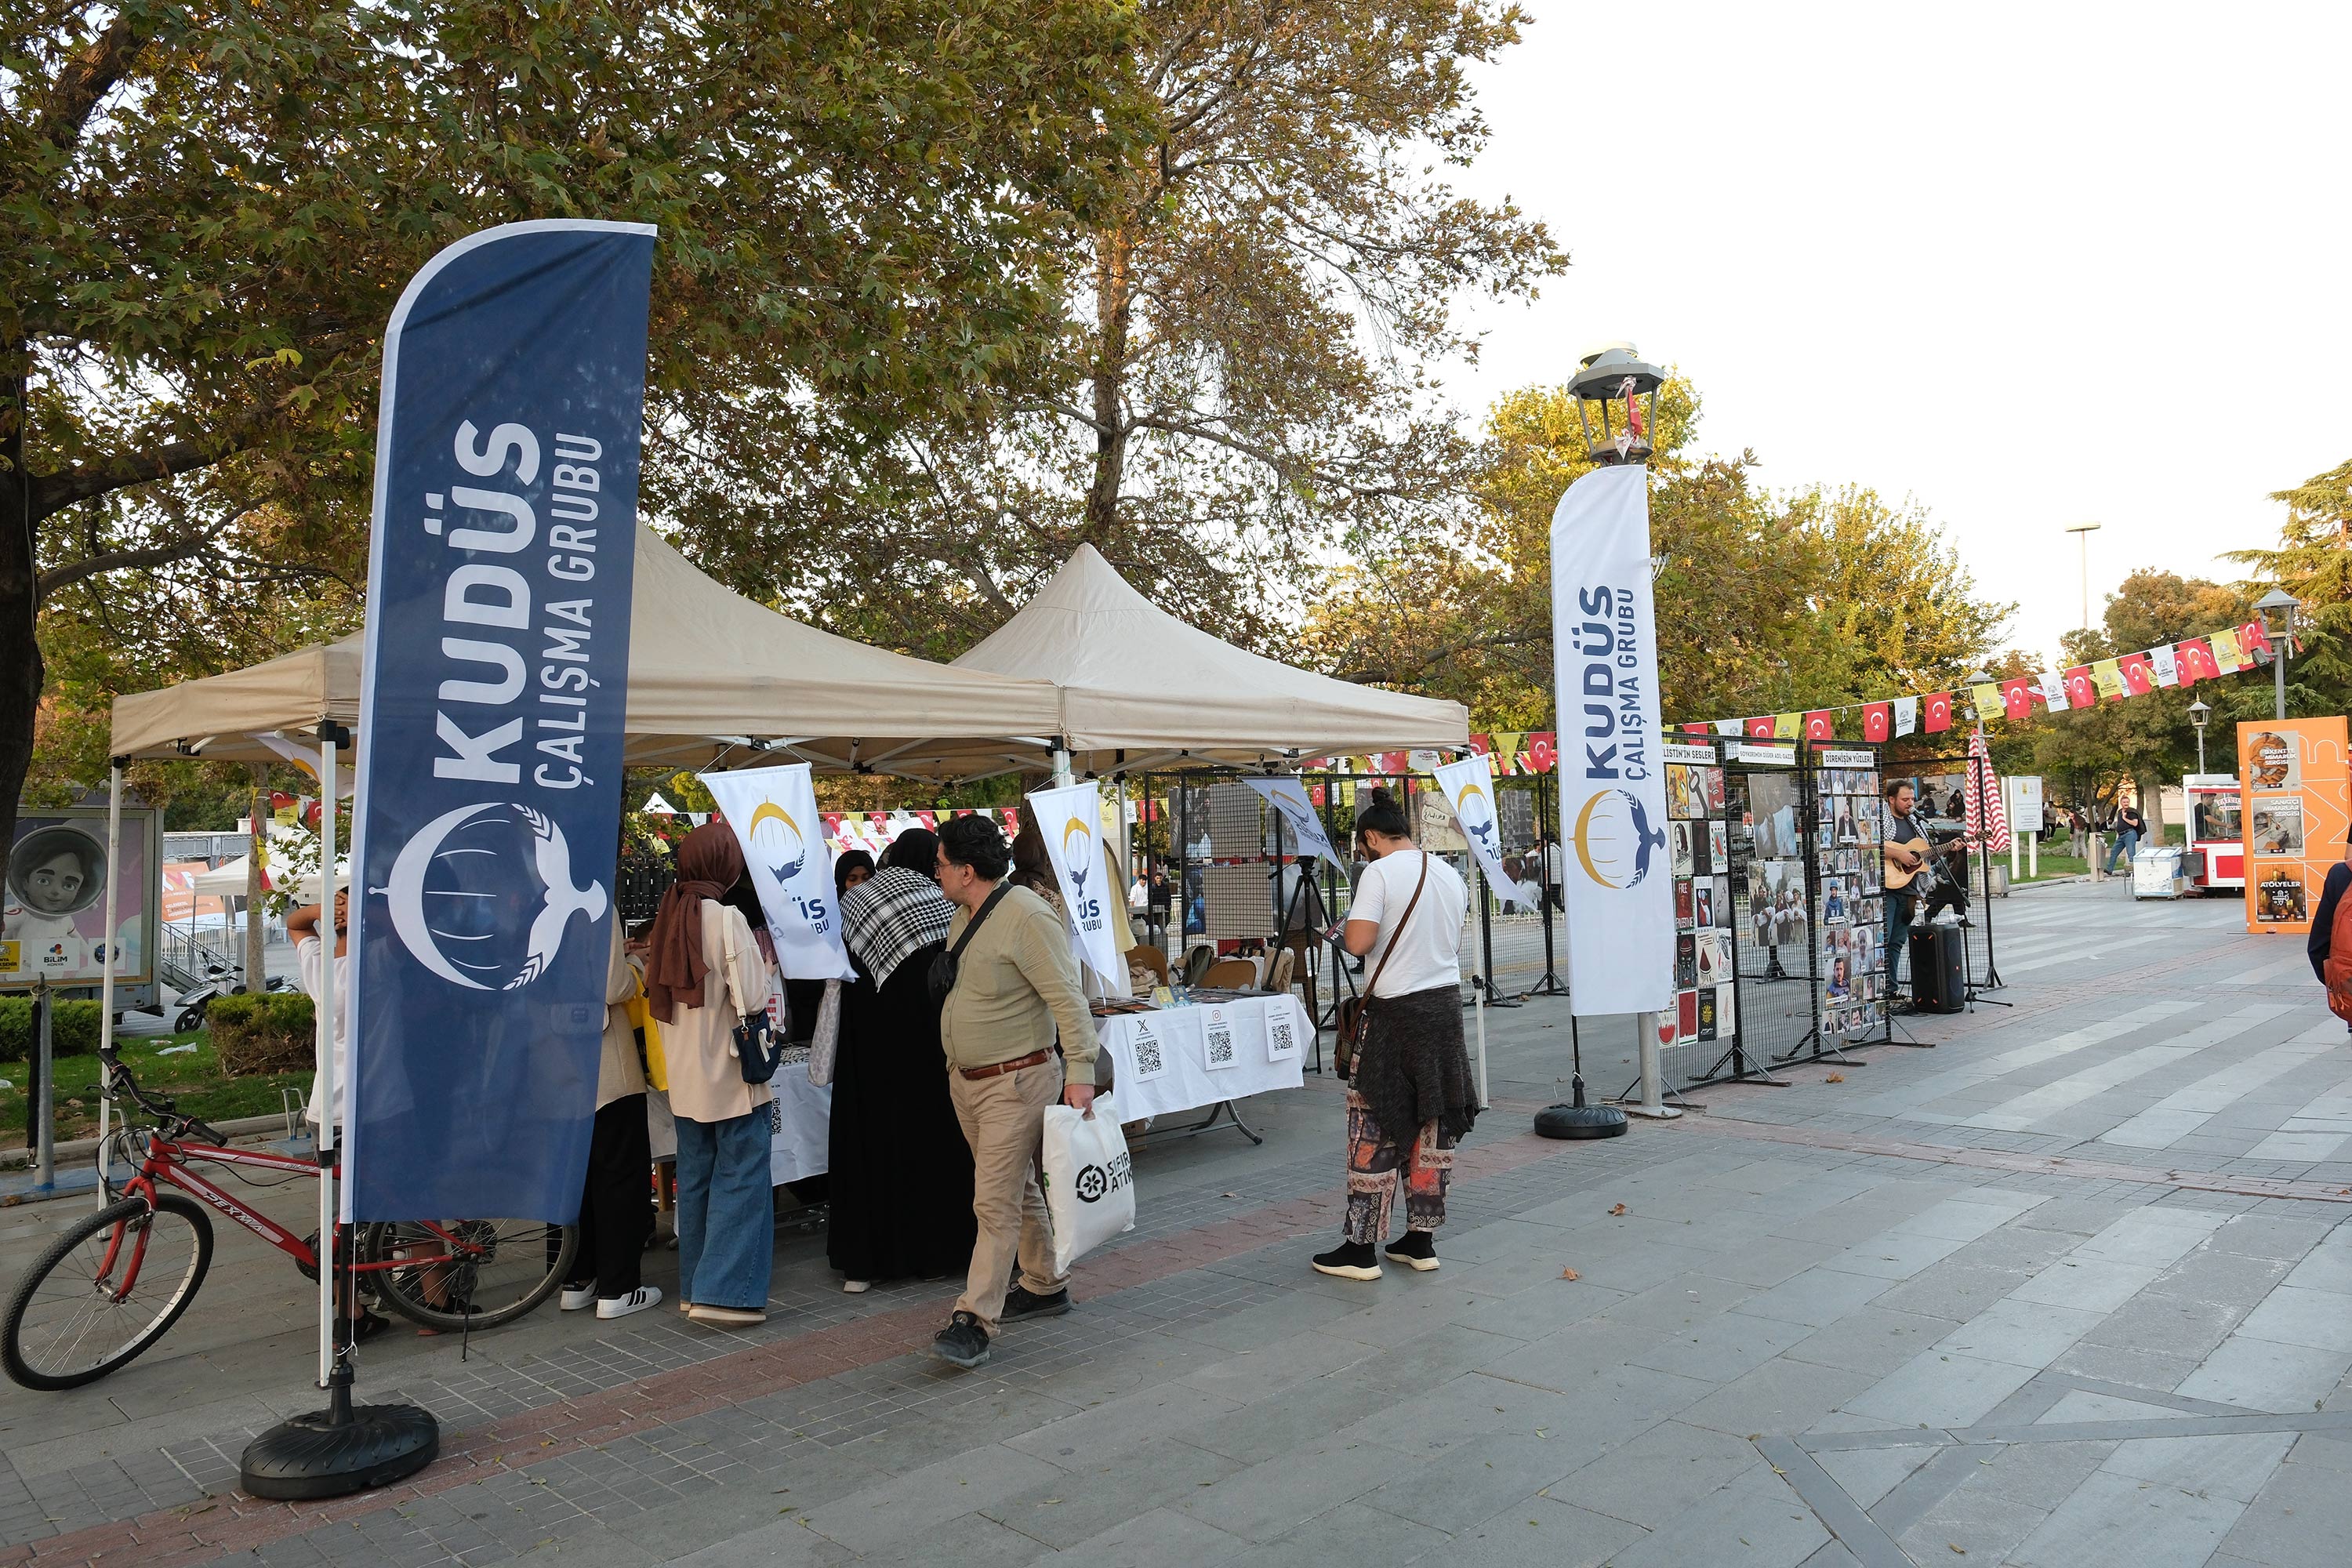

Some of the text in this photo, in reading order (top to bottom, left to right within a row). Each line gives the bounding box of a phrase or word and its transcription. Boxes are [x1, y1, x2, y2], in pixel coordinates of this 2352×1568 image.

[424, 419, 541, 784] KUDÜS
[534, 432, 603, 790] ÇALIŞMA GRUBU
[1571, 585, 1620, 779] KUDÜS
[1617, 588, 1652, 781] ÇALIŞMA GRUBU
[1663, 746, 1715, 760] LİSTİN'İN SESLERİ
[1825, 752, 1872, 765] DİRENİŞİN YÜZLERİ
[1081, 918, 1102, 932] RUBU
